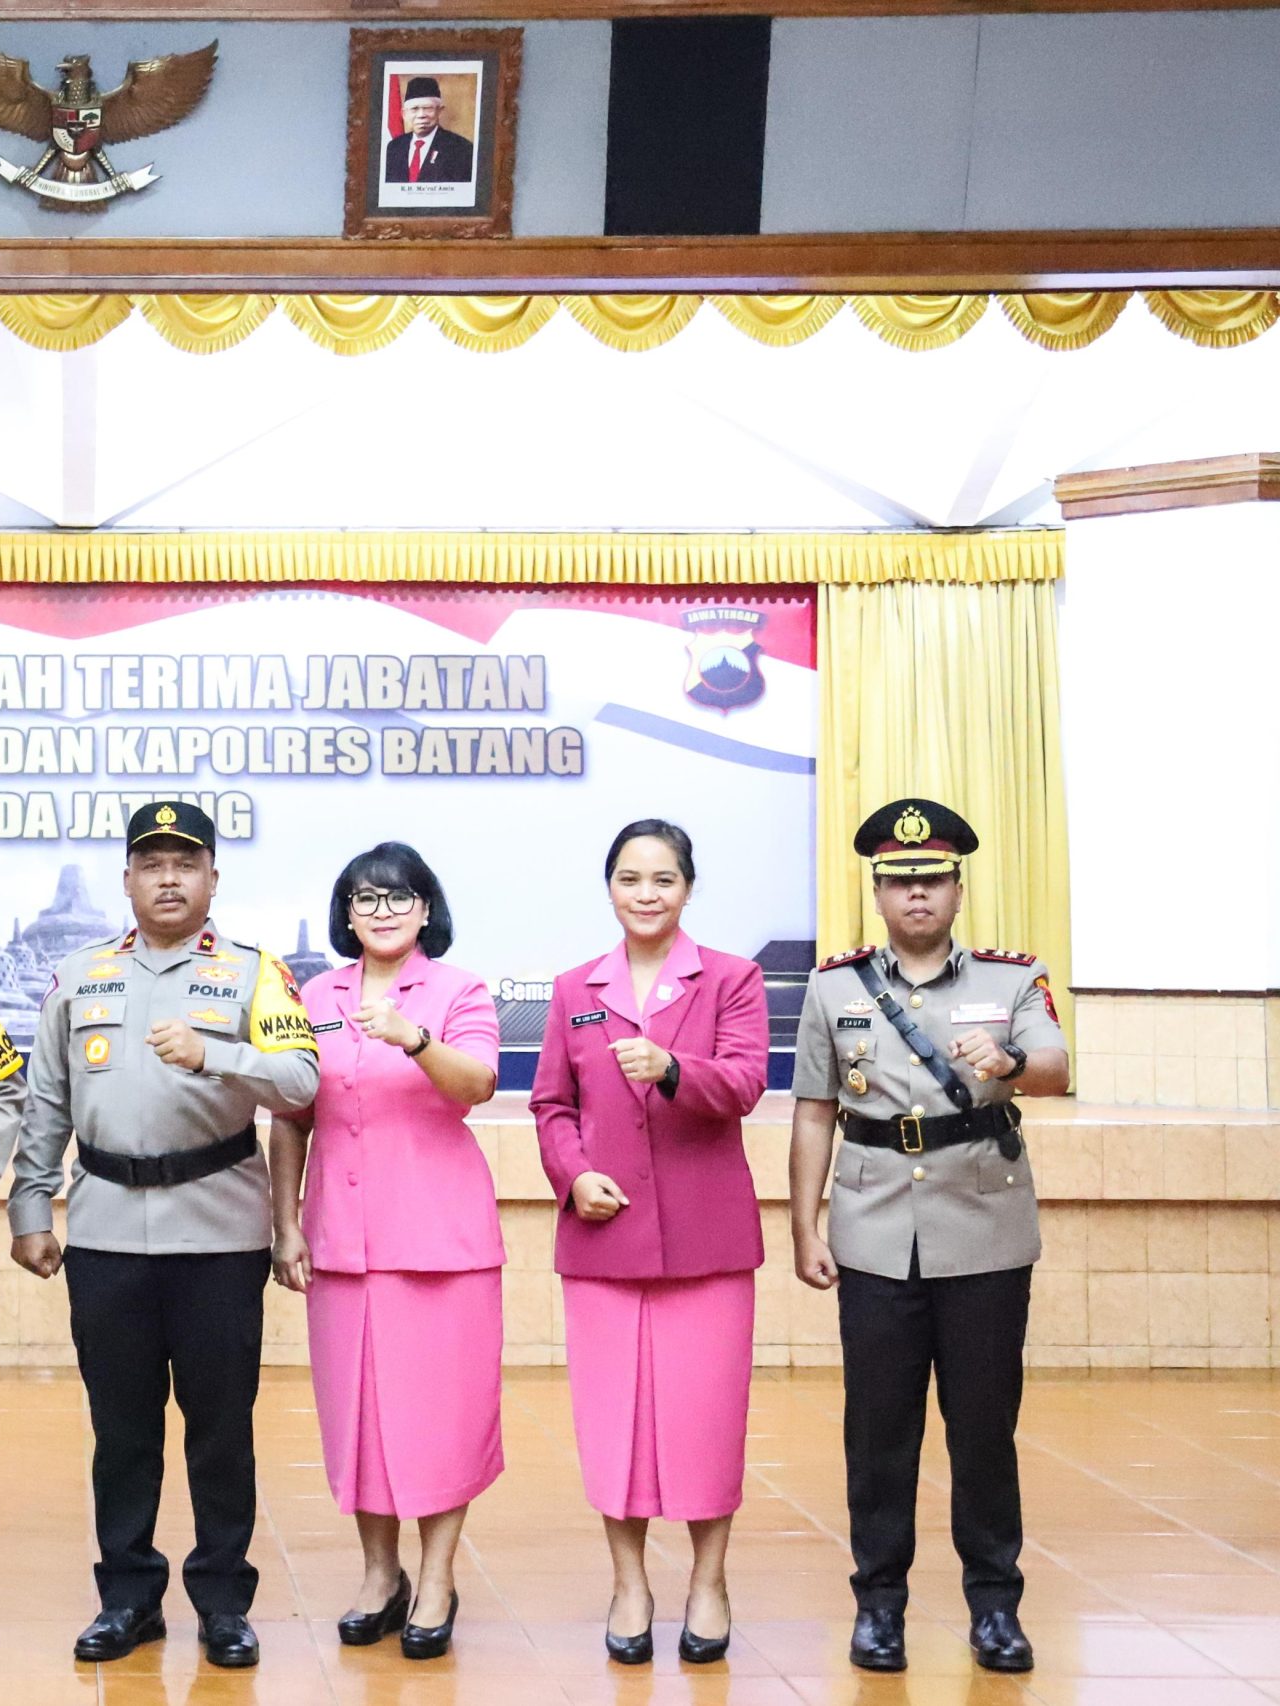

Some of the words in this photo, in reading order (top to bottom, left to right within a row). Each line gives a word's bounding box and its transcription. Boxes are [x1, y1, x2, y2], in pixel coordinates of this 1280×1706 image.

[686, 609, 717, 623] JAWA
[718, 609, 759, 623] TENGAH
[74, 653, 295, 712] TERIMA
[302, 653, 546, 711] JABATAN
[106, 726, 372, 777] KAPOLRES
[381, 725, 583, 776] BATANG
[67, 790, 255, 840] JATG
[76, 983, 98, 995] AGUS
[98, 982, 125, 994] SURYO
[188, 984, 238, 998] POLRI
